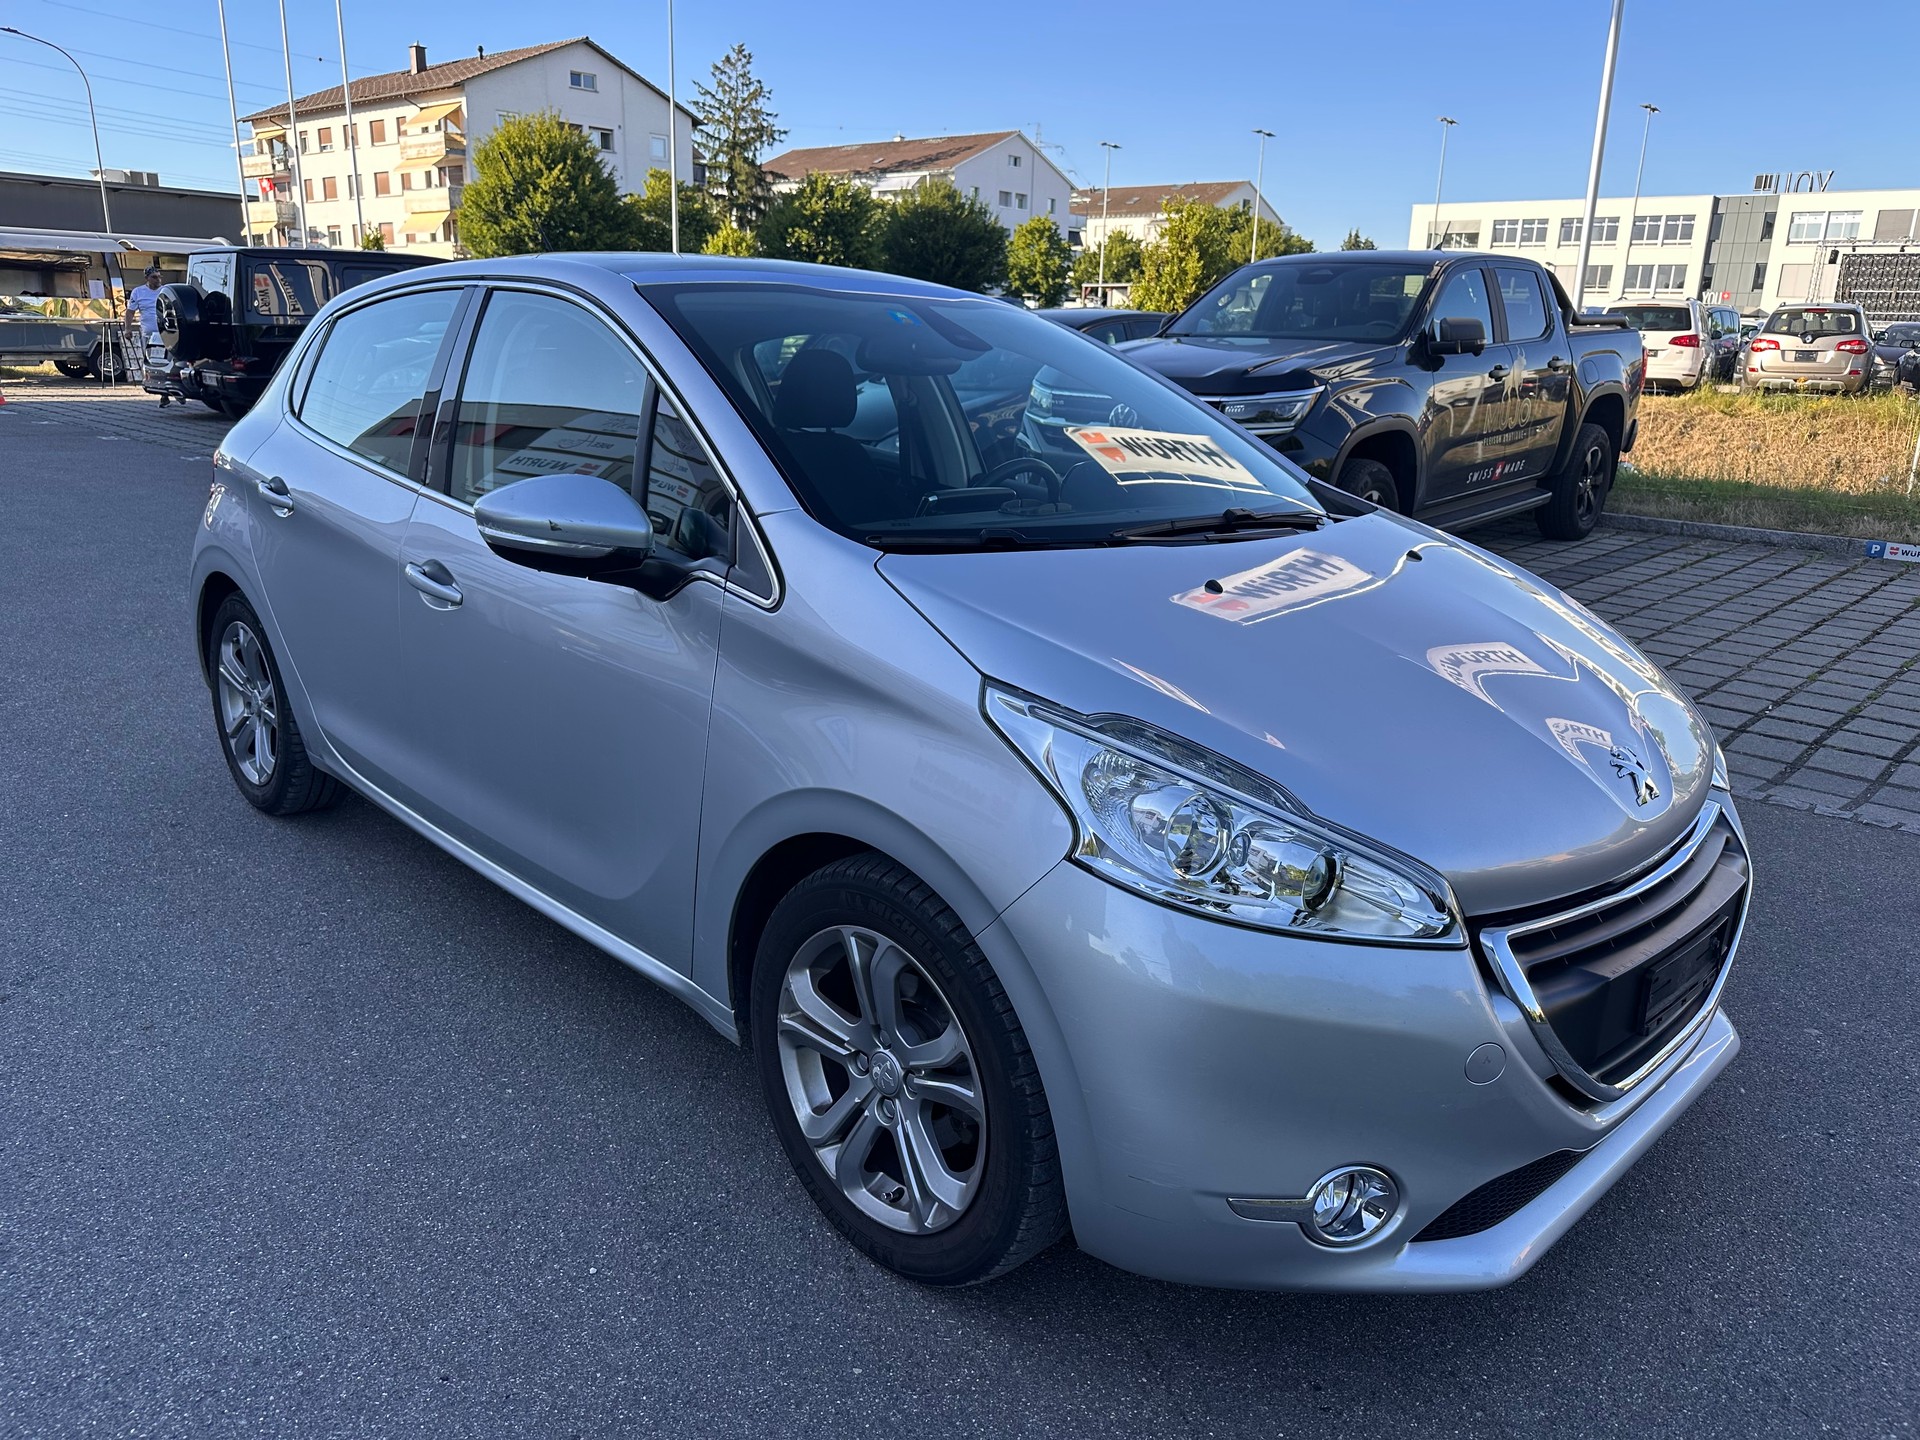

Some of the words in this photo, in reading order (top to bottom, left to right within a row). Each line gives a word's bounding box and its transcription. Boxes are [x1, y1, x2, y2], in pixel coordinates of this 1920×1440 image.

[1702, 291, 1722, 304] YOU
[1111, 436, 1237, 470] WÜRTH
[1466, 467, 1494, 484] SWISS
[1503, 459, 1526, 475] MADE
[1870, 544, 1881, 554] P
[1224, 554, 1344, 600] WÜRTH
